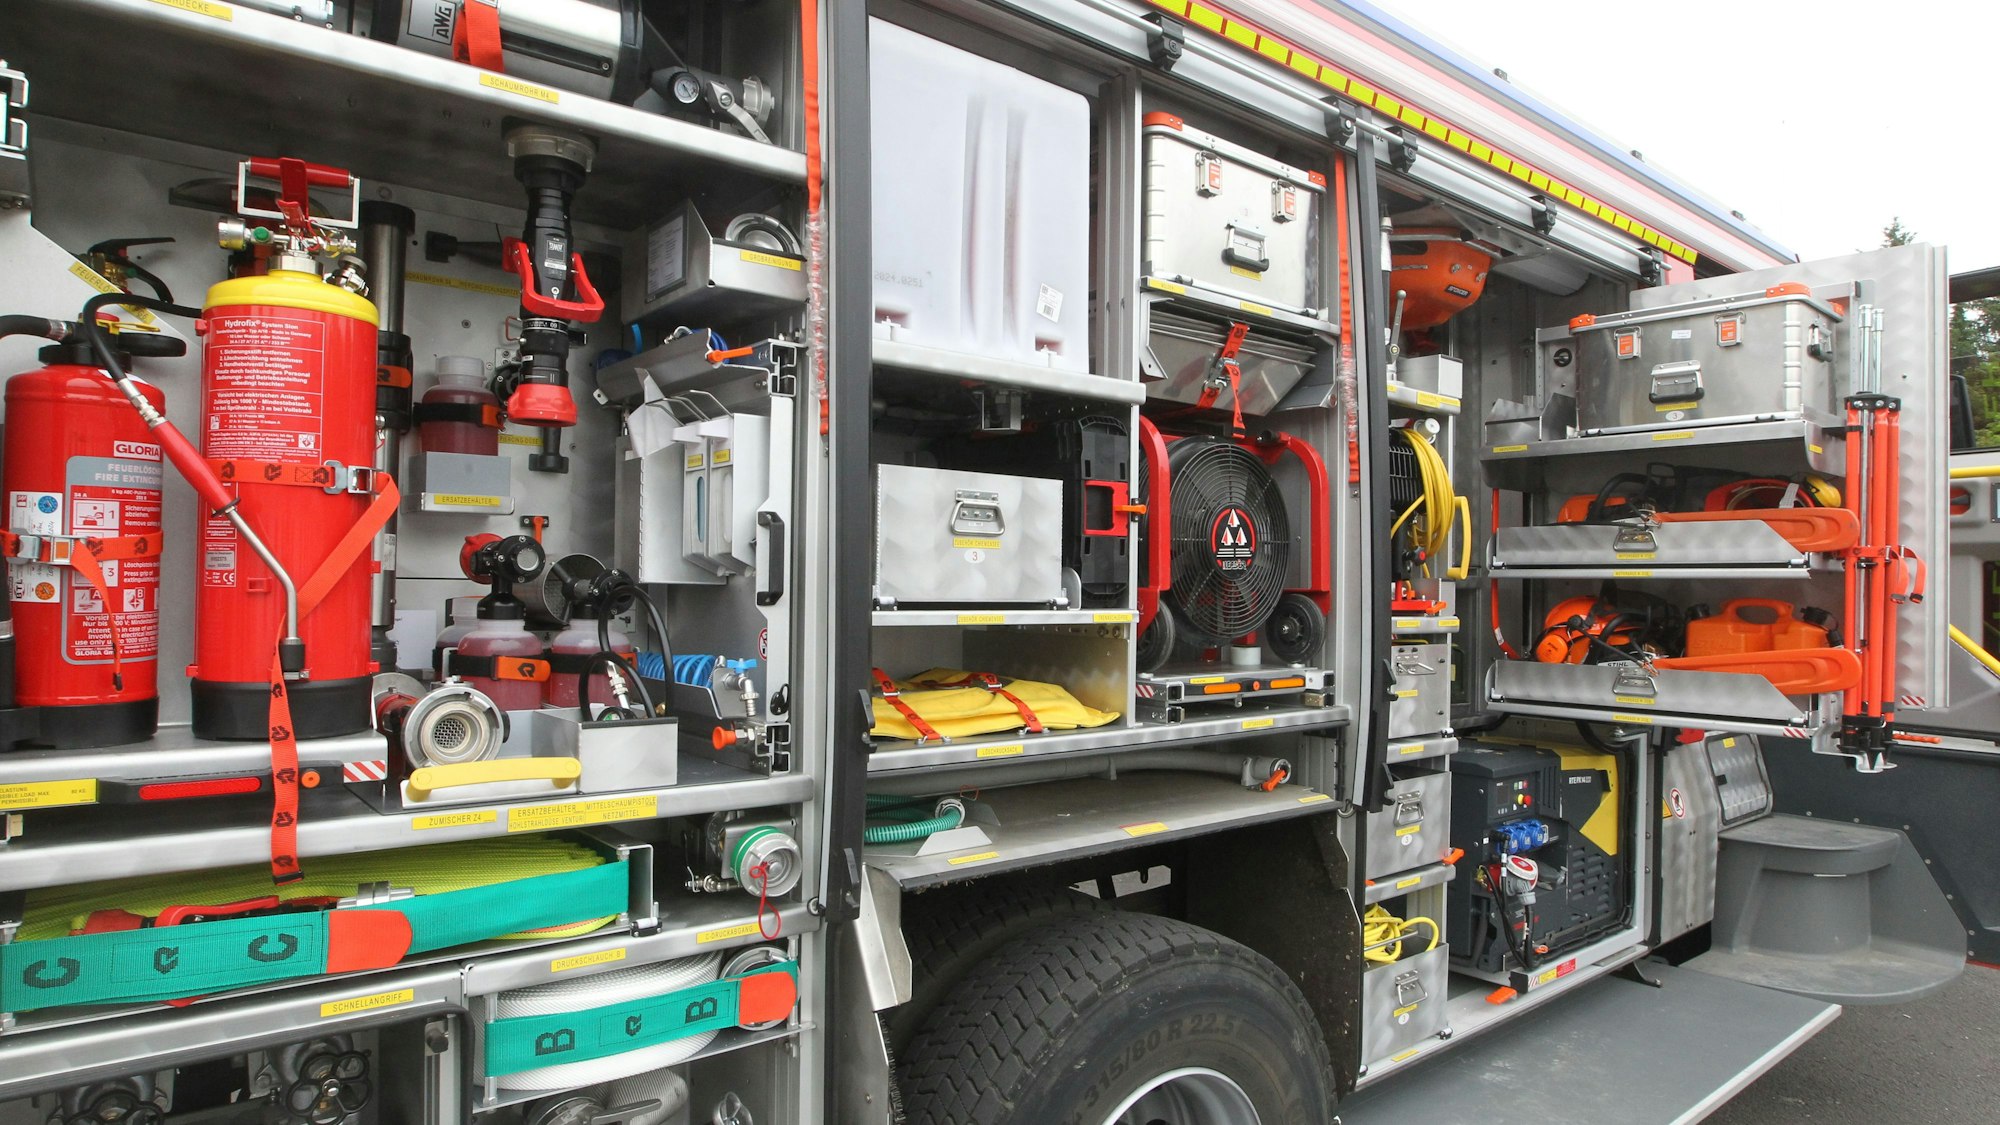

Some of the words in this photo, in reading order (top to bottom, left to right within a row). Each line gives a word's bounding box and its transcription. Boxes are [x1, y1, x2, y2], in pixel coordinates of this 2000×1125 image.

[435, 6, 452, 39] AWG
[490, 77, 539, 96] SCHAUMROHR
[280, 393, 305, 401] Anlagen
[115, 443, 160, 457] GLORIA
[94, 473, 119, 482] FIRE
[442, 496, 492, 505] ERSATZBEHÄLTER
[109, 510, 115, 519] 1
[972, 551, 978, 561] 3
[107, 568, 114, 576] 3
[92, 590, 101, 599] A
[137, 589, 144, 597] B
[89, 639, 105, 647] only
[517, 804, 576, 819] ERSATZBEHÄLTER
[586, 797, 656, 812] MITTELSCHAUMPISTOLE
[602, 808, 640, 820] NETZMITTEL
[429, 814, 472, 826] ZUMISCHER
[473, 813, 482, 823] Z4
[247, 933, 298, 962] C
[556, 952, 613, 969] DRUCKSCHLAUCH
[23, 957, 80, 989] C
[332, 992, 403, 1013] SCHNELLANGRIFF
[535, 1028, 575, 1056] B
[685, 996, 718, 1024] B
[1084, 1029, 1161, 1107] 315/80
[1166, 1019, 1184, 1042] R
[1187, 1012, 1236, 1037] 22.5
